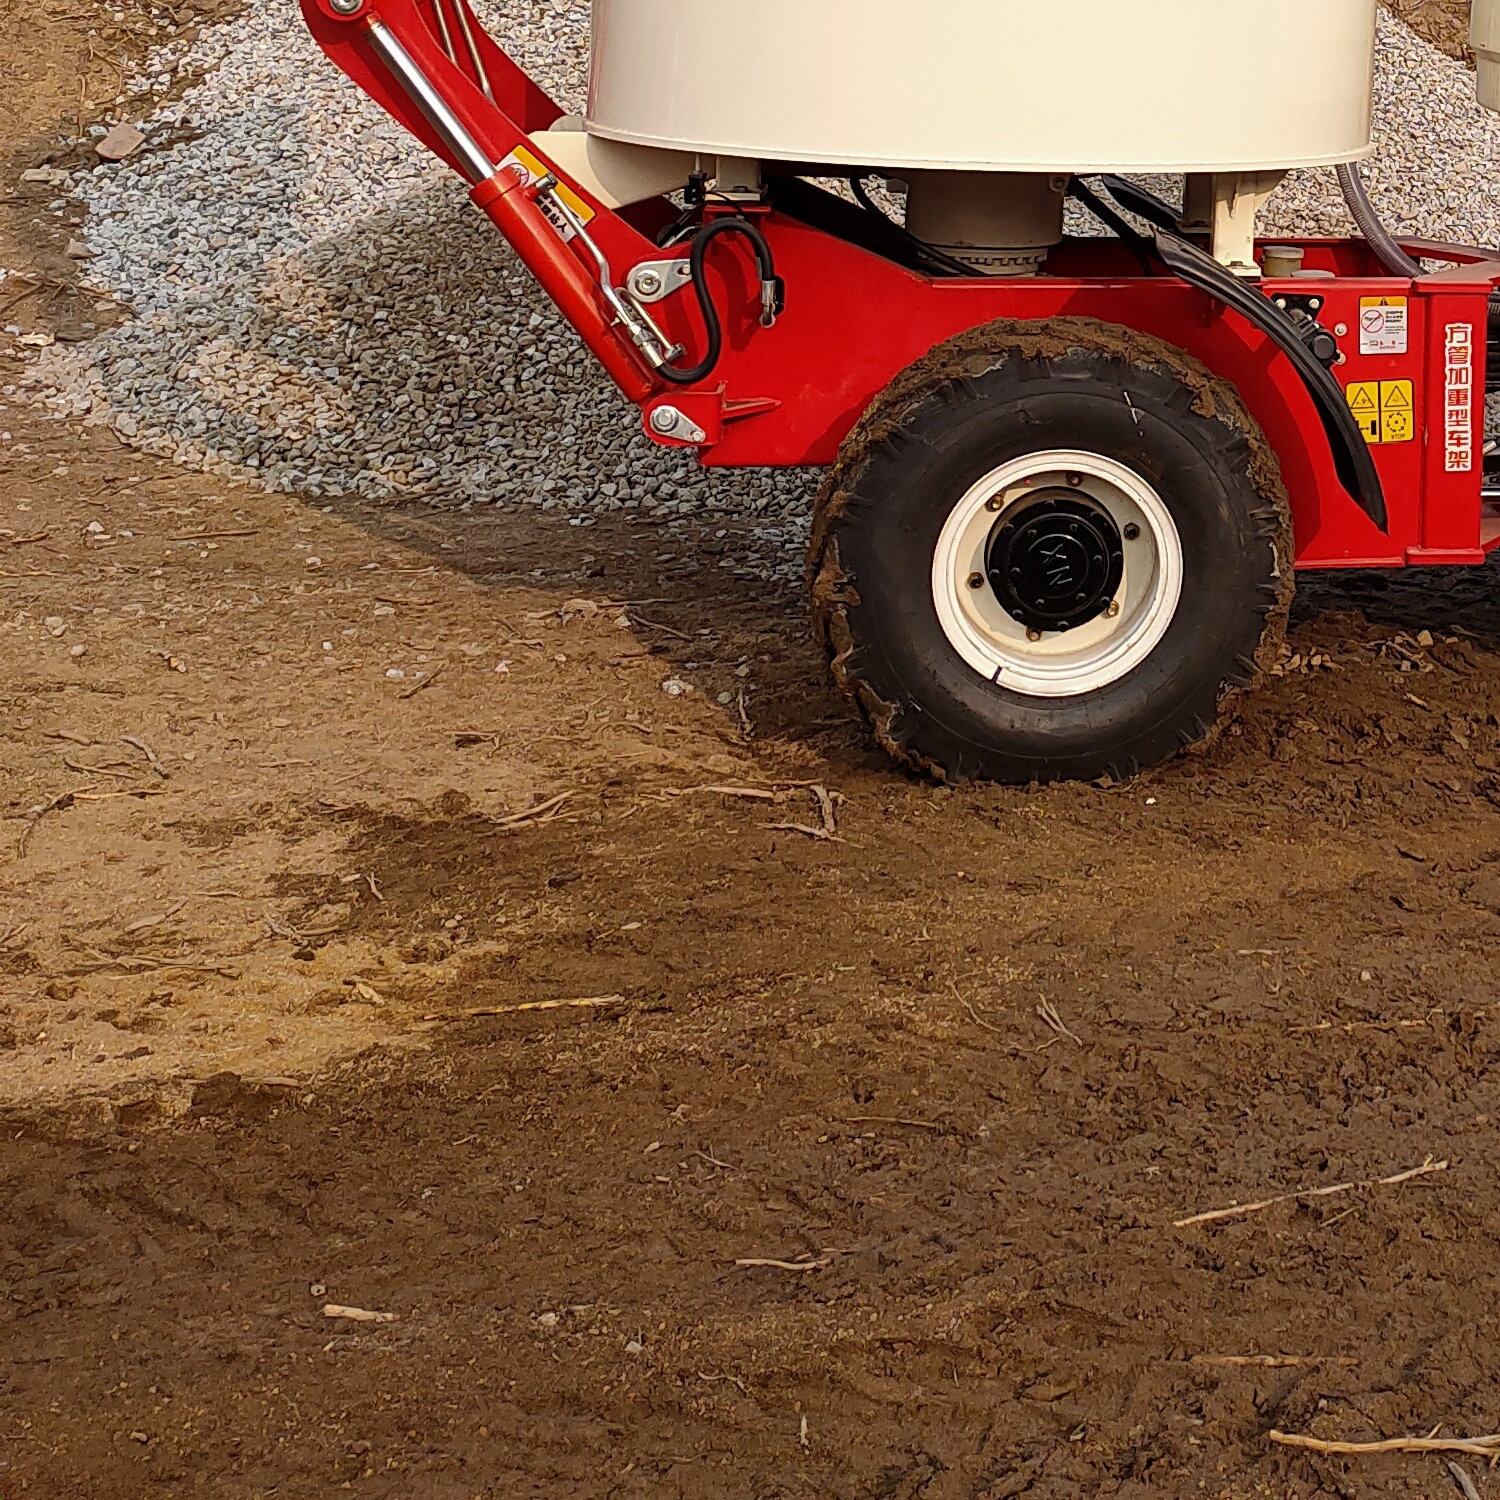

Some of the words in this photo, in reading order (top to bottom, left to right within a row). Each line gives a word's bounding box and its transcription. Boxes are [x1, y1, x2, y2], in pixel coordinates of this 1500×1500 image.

[1447, 325, 1469, 469] 方管加重型车架
